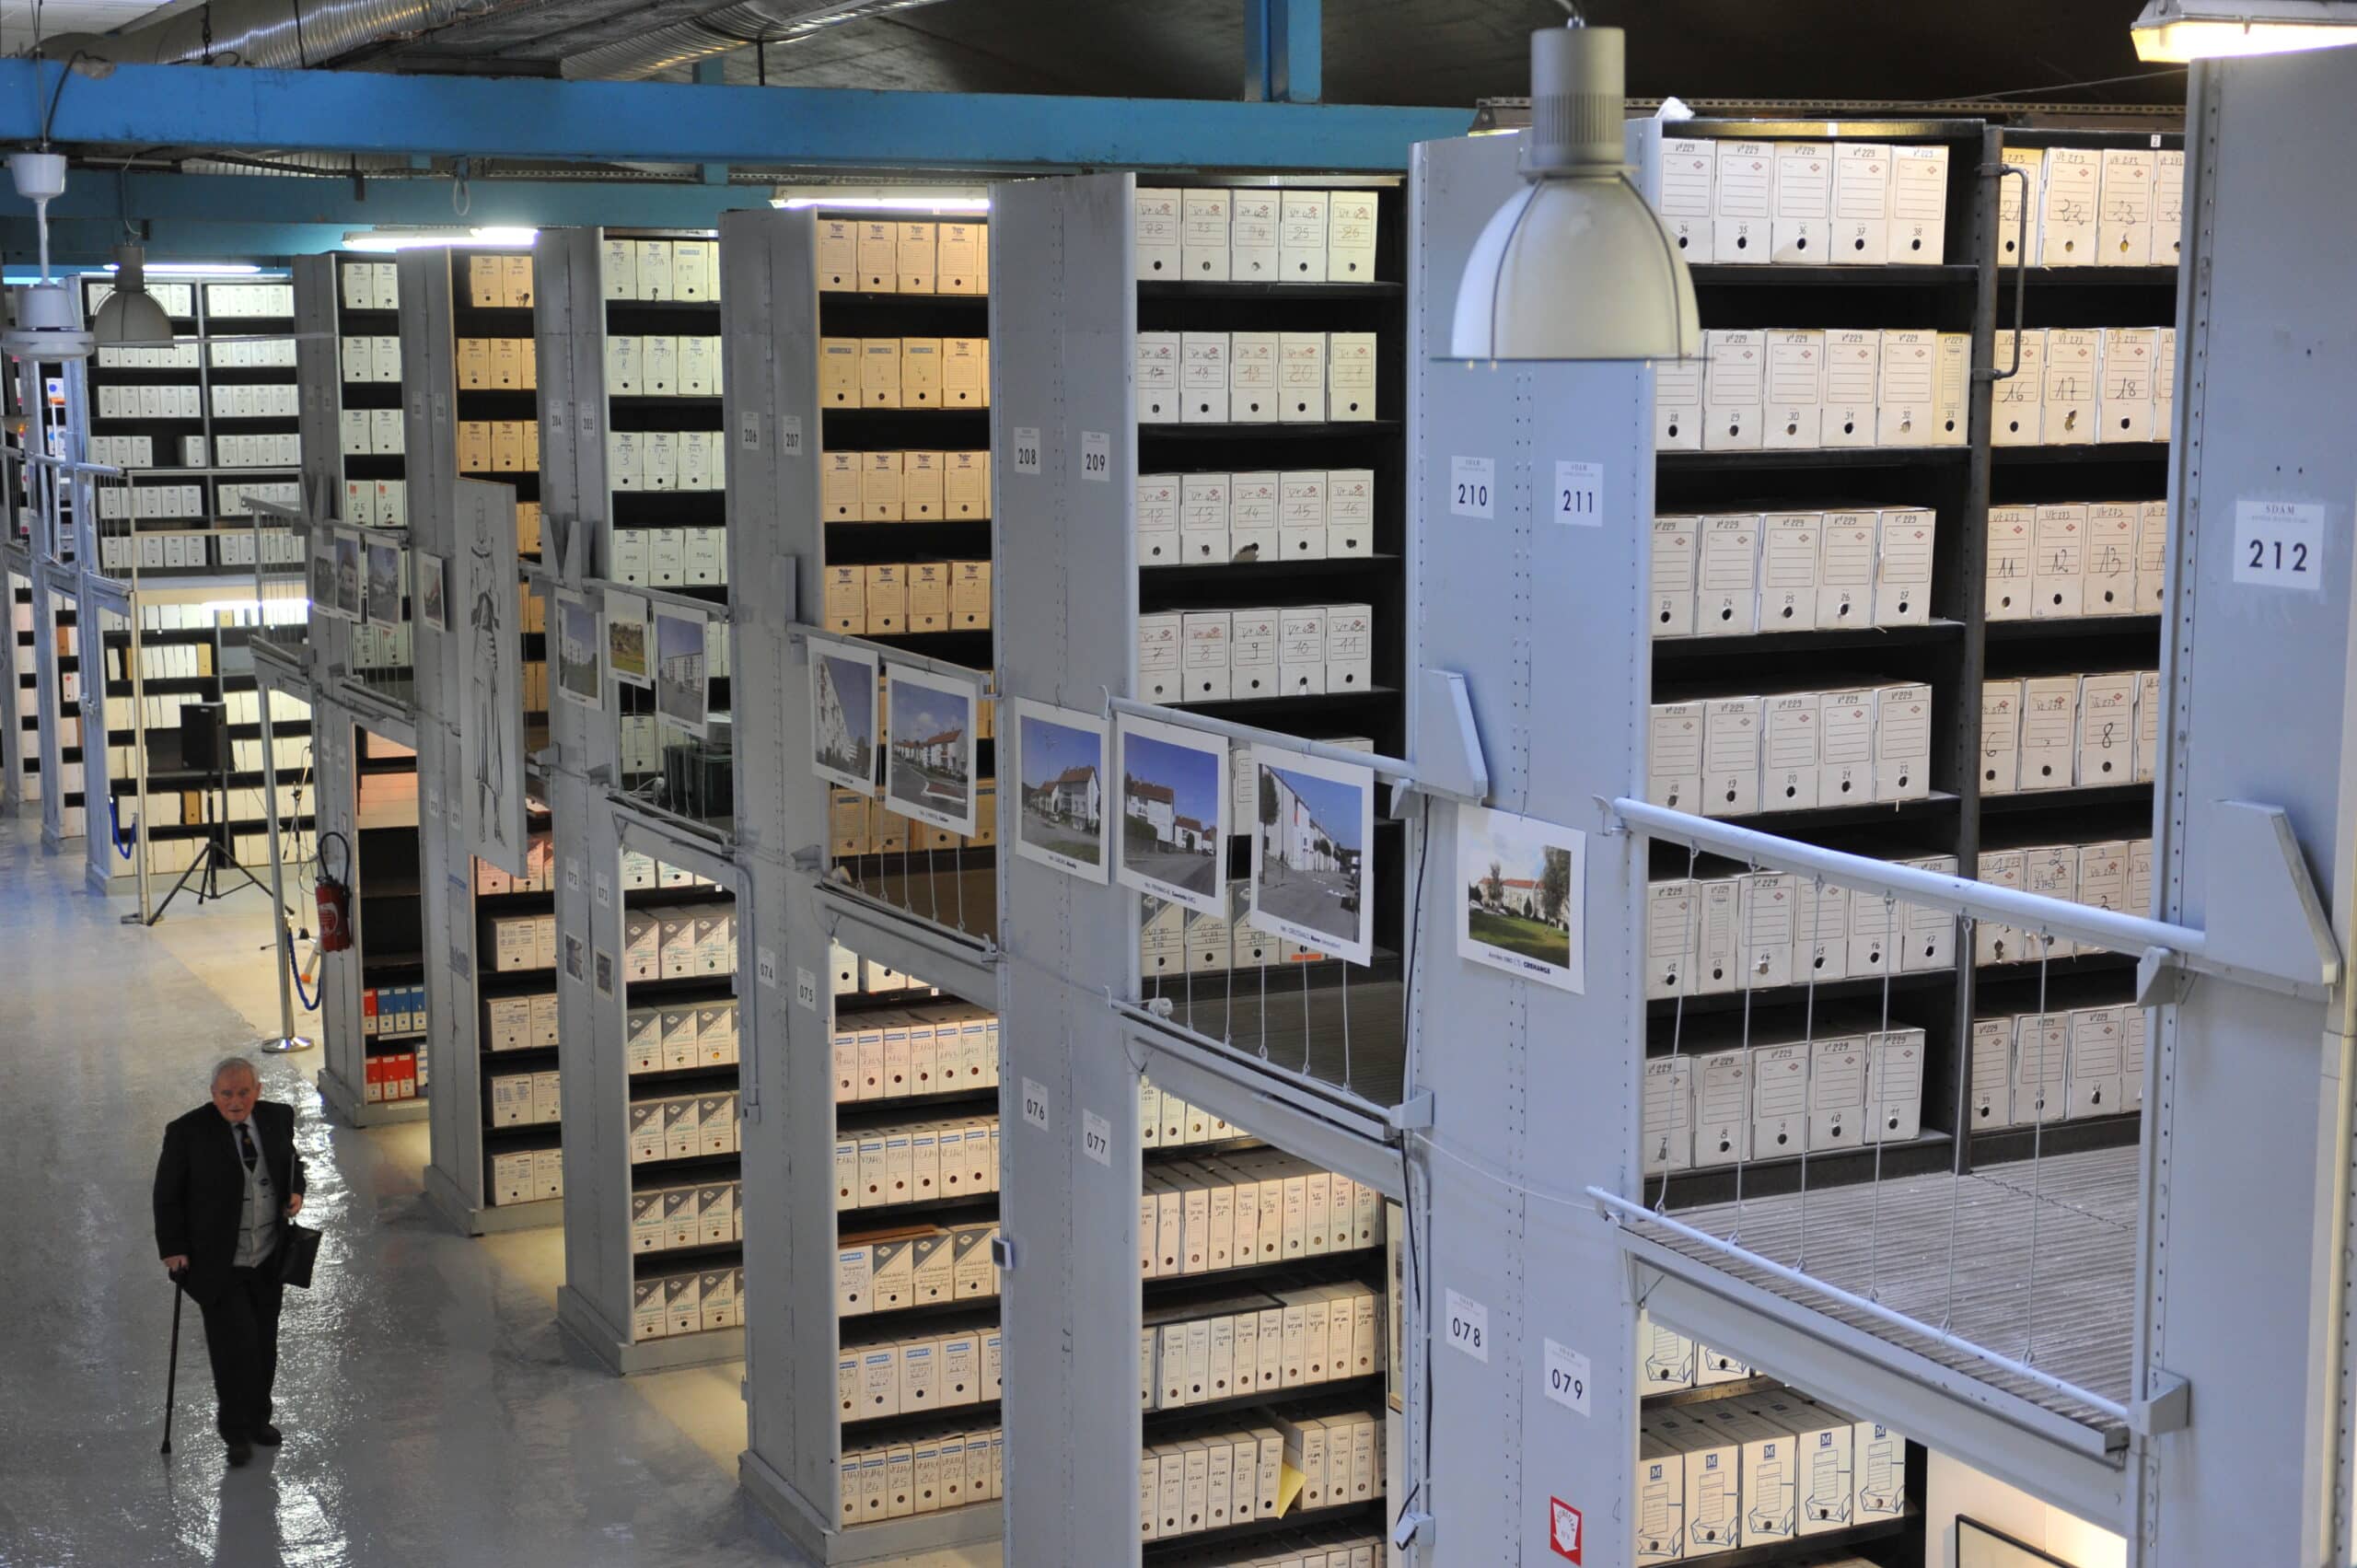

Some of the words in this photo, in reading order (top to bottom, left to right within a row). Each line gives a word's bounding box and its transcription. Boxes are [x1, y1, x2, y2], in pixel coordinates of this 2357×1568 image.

[2060, 199, 2084, 225] 22
[2114, 201, 2136, 225] 23
[1293, 226, 1309, 238] 25
[1679, 225, 1689, 234] 34
[1738, 225, 1748, 235] 35
[1798, 226, 1806, 235] 36
[1857, 226, 1866, 236] 37
[1913, 227, 1922, 237] 38
[1290, 365, 1312, 382] 20
[2003, 383, 2024, 402] 16
[2056, 377, 2076, 401] 17
[2117, 377, 2136, 400] 18
[1844, 412, 1854, 420] 31
[1902, 411, 1911, 419] 32
[1945, 411, 1955, 419] 33
[744, 427, 757, 442] 206
[786, 433, 798, 447] 207
[1018, 447, 1036, 464] 208
[1086, 453, 1105, 471] 209
[1458, 483, 1487, 505] 210
[1563, 490, 1593, 513] 211
[1294, 504, 1310, 517] 15
[2108, 508, 2123, 517] 273
[2052, 549, 2069, 573] 12
[2099, 546, 2121, 578] 13
[2249, 540, 2307, 572] 212
[1999, 557, 2014, 578] 11
[1785, 595, 1794, 604] 25
[1841, 592, 1850, 601] 26
[1900, 591, 1909, 599] 27
[1251, 642, 1259, 659] 9
[1340, 637, 1356, 652] 11
[1201, 645, 1209, 662] 8
[2102, 722, 2113, 749] 8
[1986, 731, 1996, 757] 6
[1899, 764, 1909, 773] 22
[1788, 774, 1797, 784] 20
[1842, 771, 1851, 779] 21
[1762, 877, 1779, 886] 229
[1871, 941, 1880, 949] 16
[1927, 935, 1935, 944] 17
[761, 963, 772, 980] 074
[1667, 963, 1677, 972] 12
[800, 984, 813, 1002] 075
[1832, 1042, 1849, 1051] 229
[1981, 1097, 1990, 1105] 39
[1027, 1098, 1044, 1120] 076
[1889, 1108, 1899, 1116] 11
[1831, 1114, 1841, 1123] 10
[1780, 1122, 1786, 1132] 9
[1720, 1129, 1728, 1139] 8
[1087, 1132, 1106, 1154] 077
[1453, 1318, 1480, 1347] 078
[1552, 1369, 1583, 1400] 079
[1875, 1425, 1886, 1436] M
[1821, 1434, 1831, 1446] M
[1765, 1446, 1774, 1458] M
[1707, 1457, 1717, 1468] M
[1651, 1467, 1661, 1478] M
